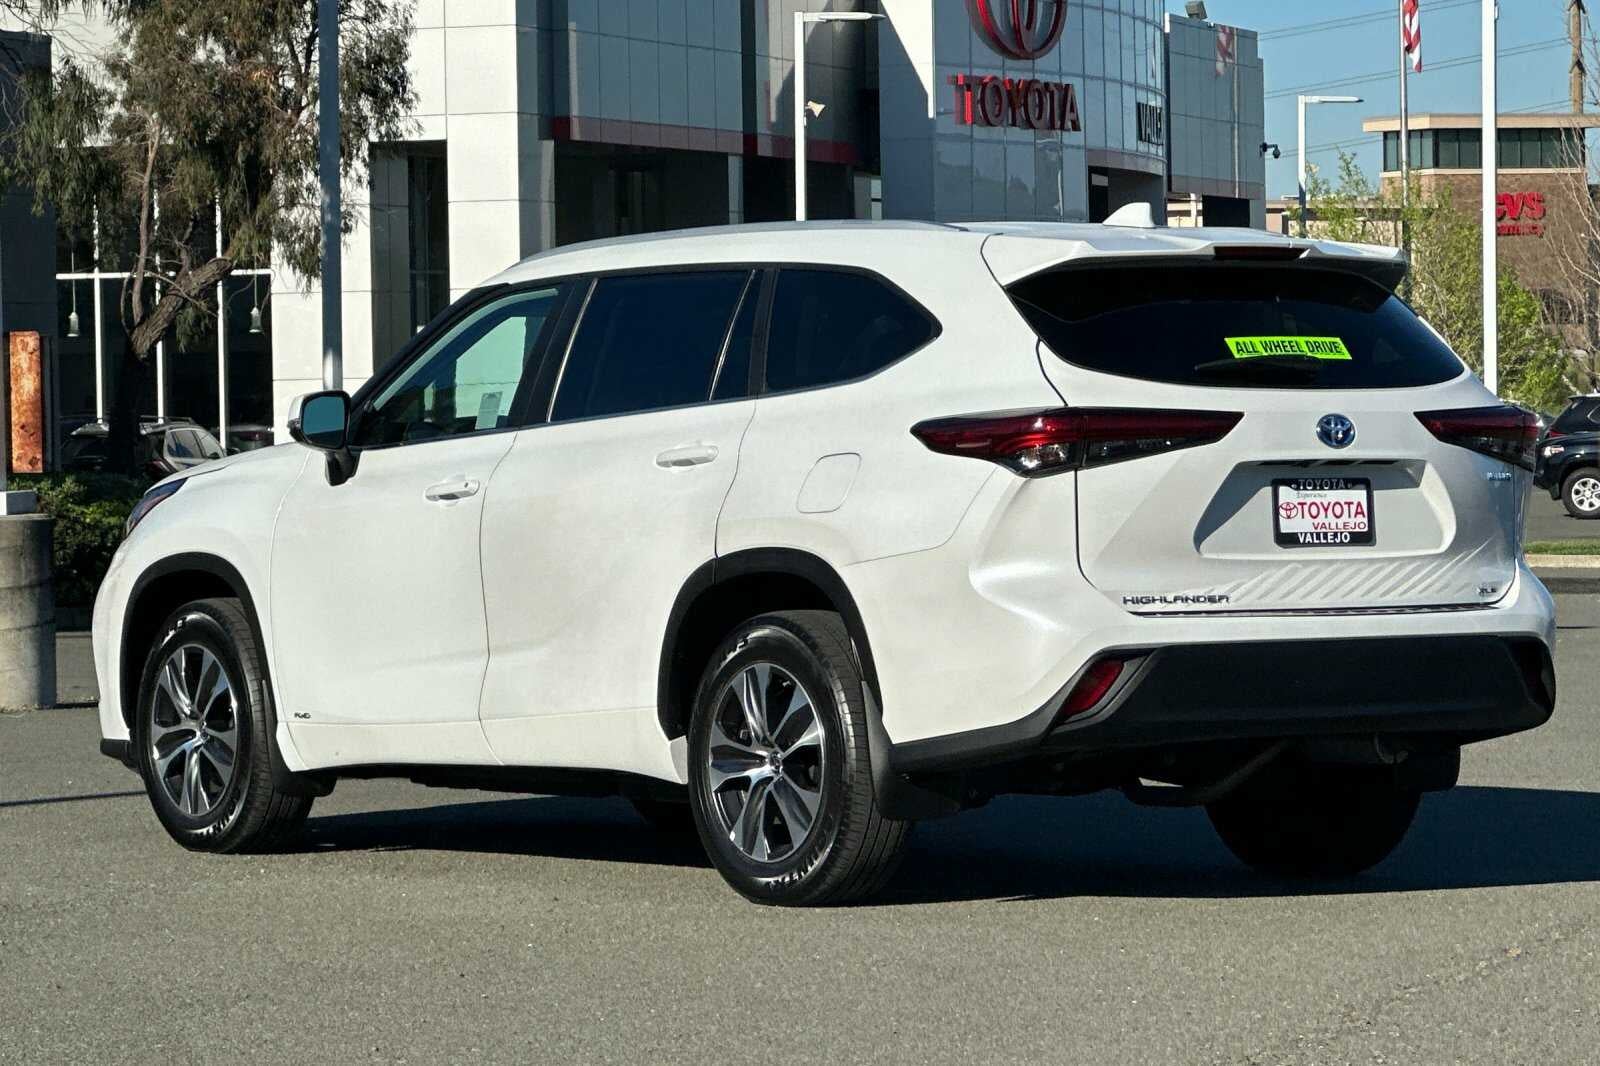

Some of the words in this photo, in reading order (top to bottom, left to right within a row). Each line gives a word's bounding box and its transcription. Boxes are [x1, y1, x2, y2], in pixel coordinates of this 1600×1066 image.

[948, 73, 1082, 132] TOYOTA
[1234, 340, 1260, 354] ALL
[1261, 340, 1304, 353] WHEEL
[1305, 340, 1342, 354] DRIVE
[1298, 479, 1346, 490] TOYOTA
[1297, 501, 1366, 519] TOYOTA
[1312, 521, 1367, 531] VALLEJO
[1298, 532, 1351, 544] VALLEJO
[1122, 594, 1230, 605] HIGHLANDER
